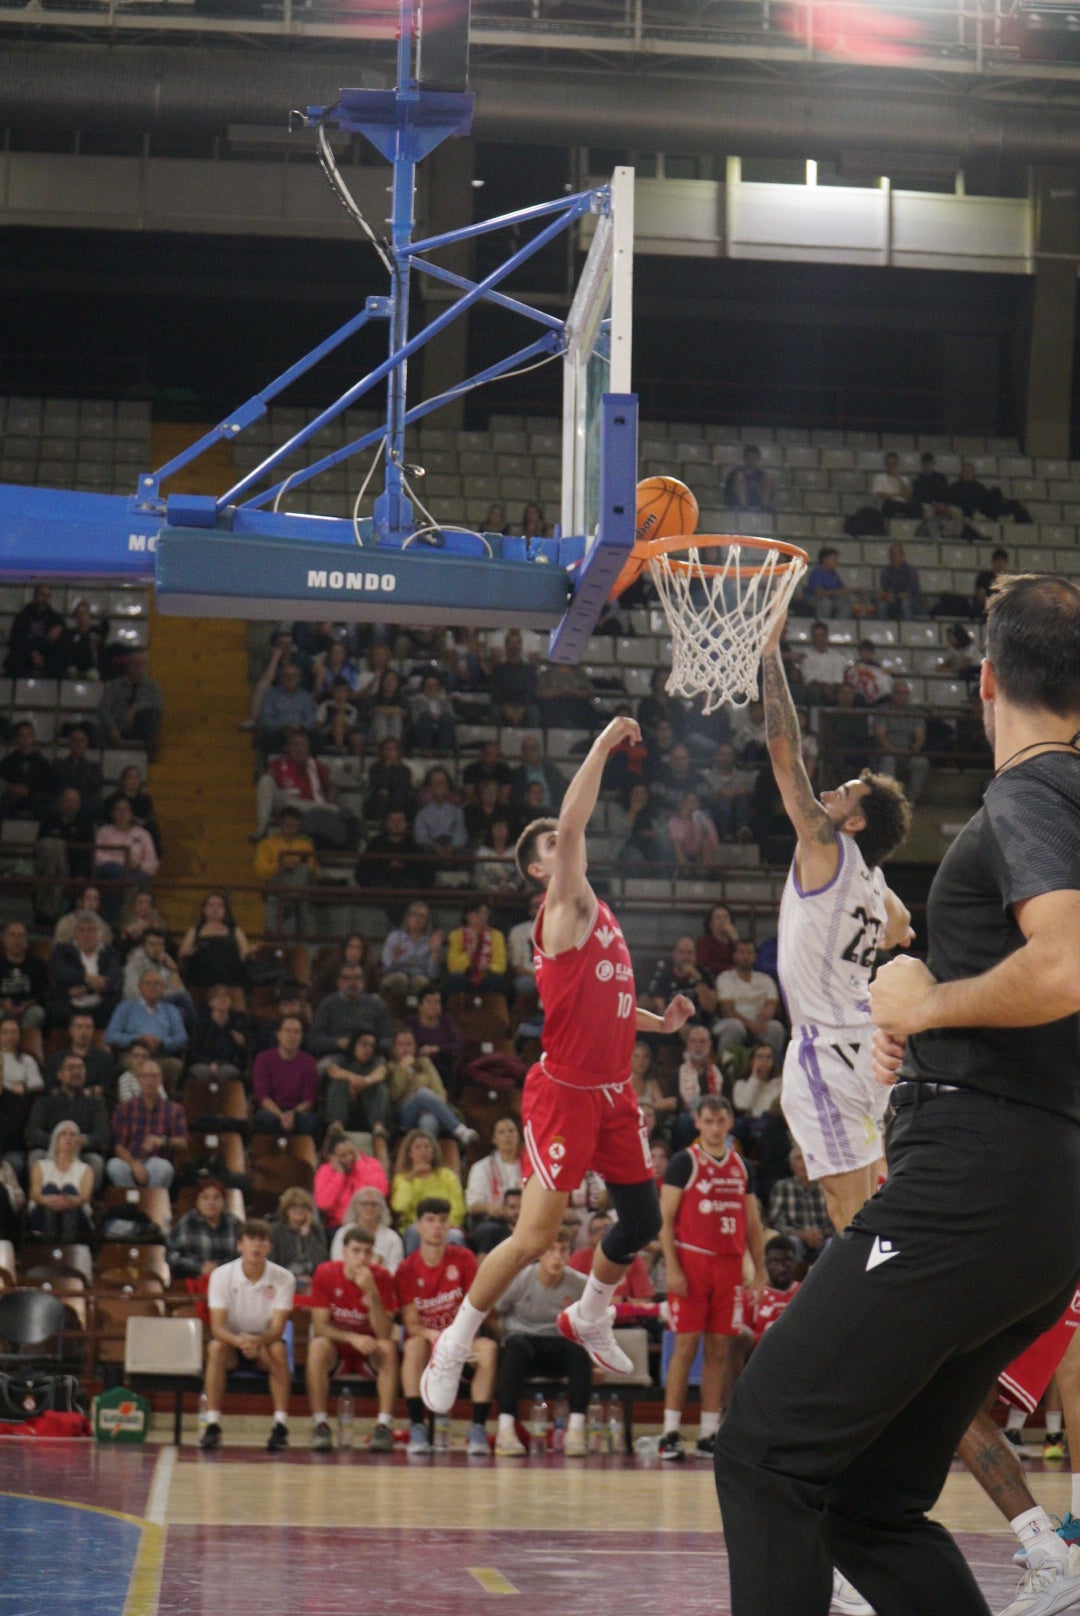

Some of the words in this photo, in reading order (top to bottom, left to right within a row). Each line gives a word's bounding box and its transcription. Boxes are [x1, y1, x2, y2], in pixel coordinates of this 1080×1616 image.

[307, 570, 396, 592] MONDO
[616, 991, 633, 1019] 10
[720, 1216, 737, 1235] 33
